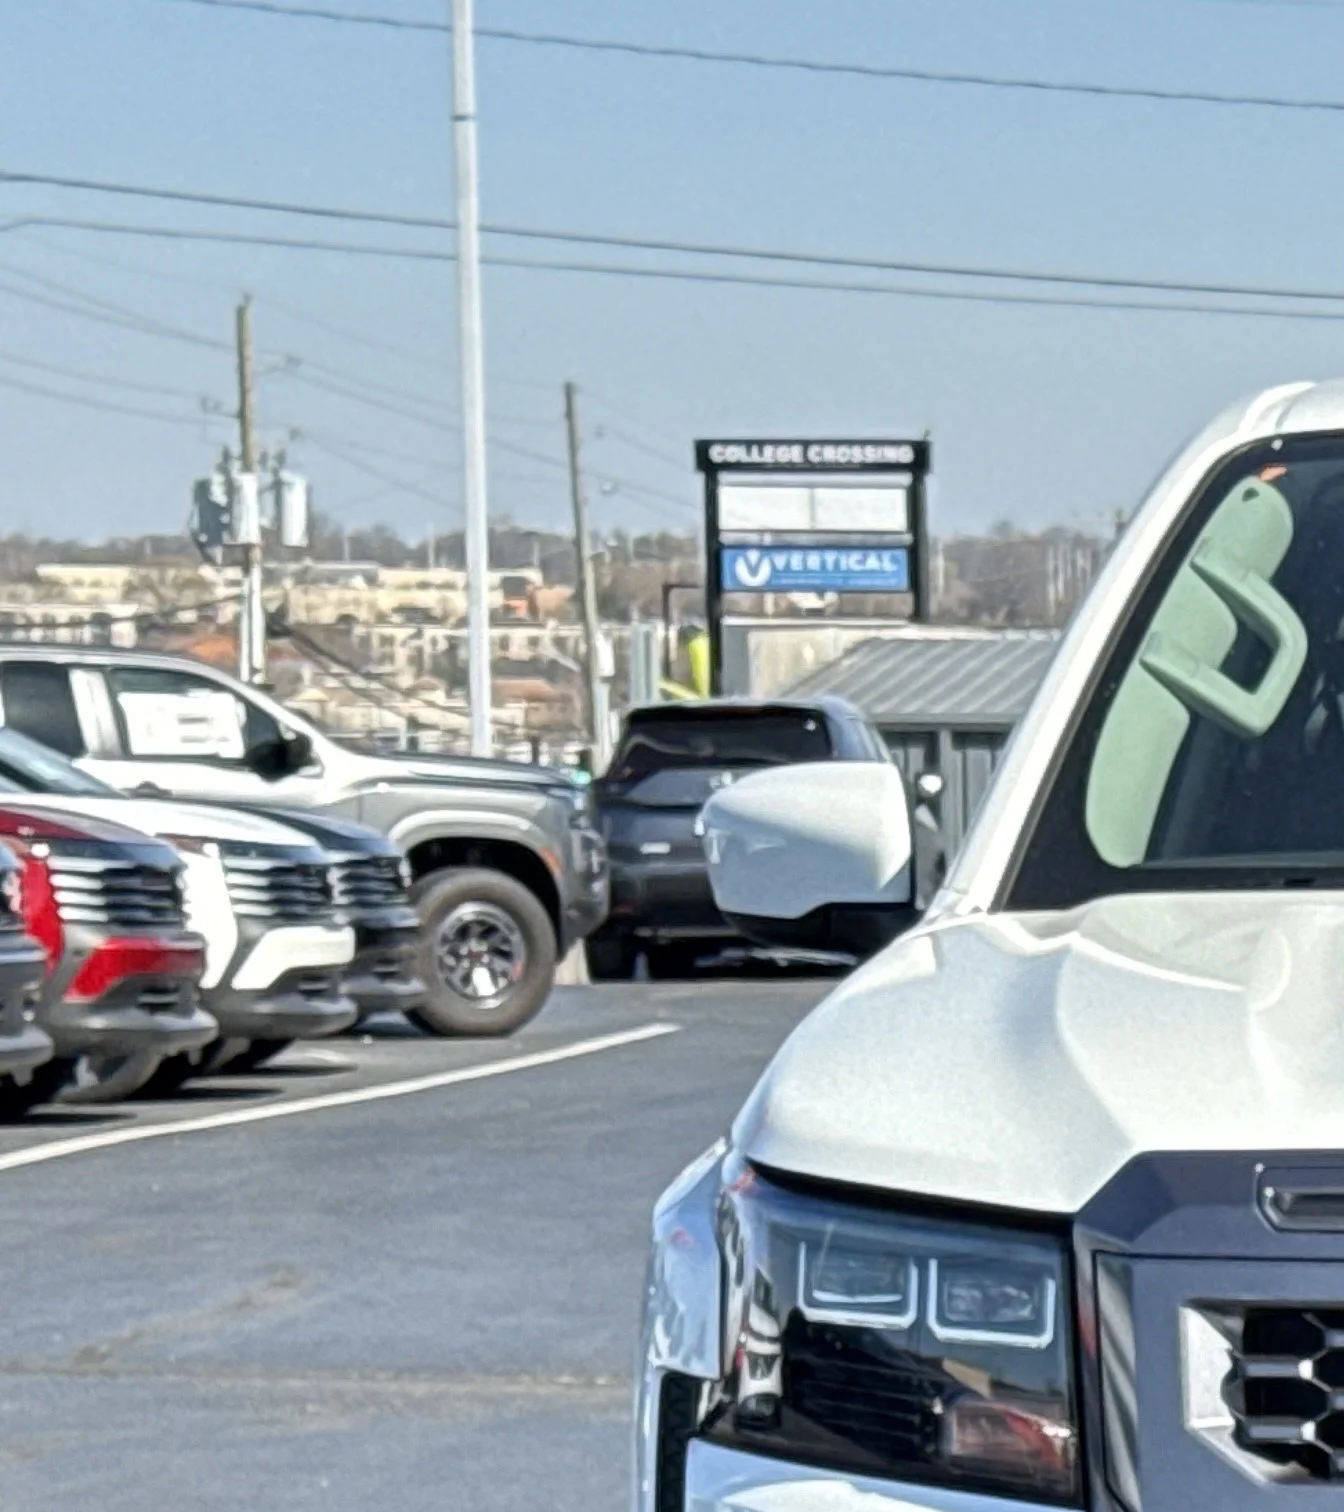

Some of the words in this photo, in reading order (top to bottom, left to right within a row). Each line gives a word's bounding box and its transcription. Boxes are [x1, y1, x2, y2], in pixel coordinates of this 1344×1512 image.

[708, 444, 804, 463] COLLEGE
[807, 444, 915, 463] CROSSING
[771, 551, 897, 571] VERTICAL
